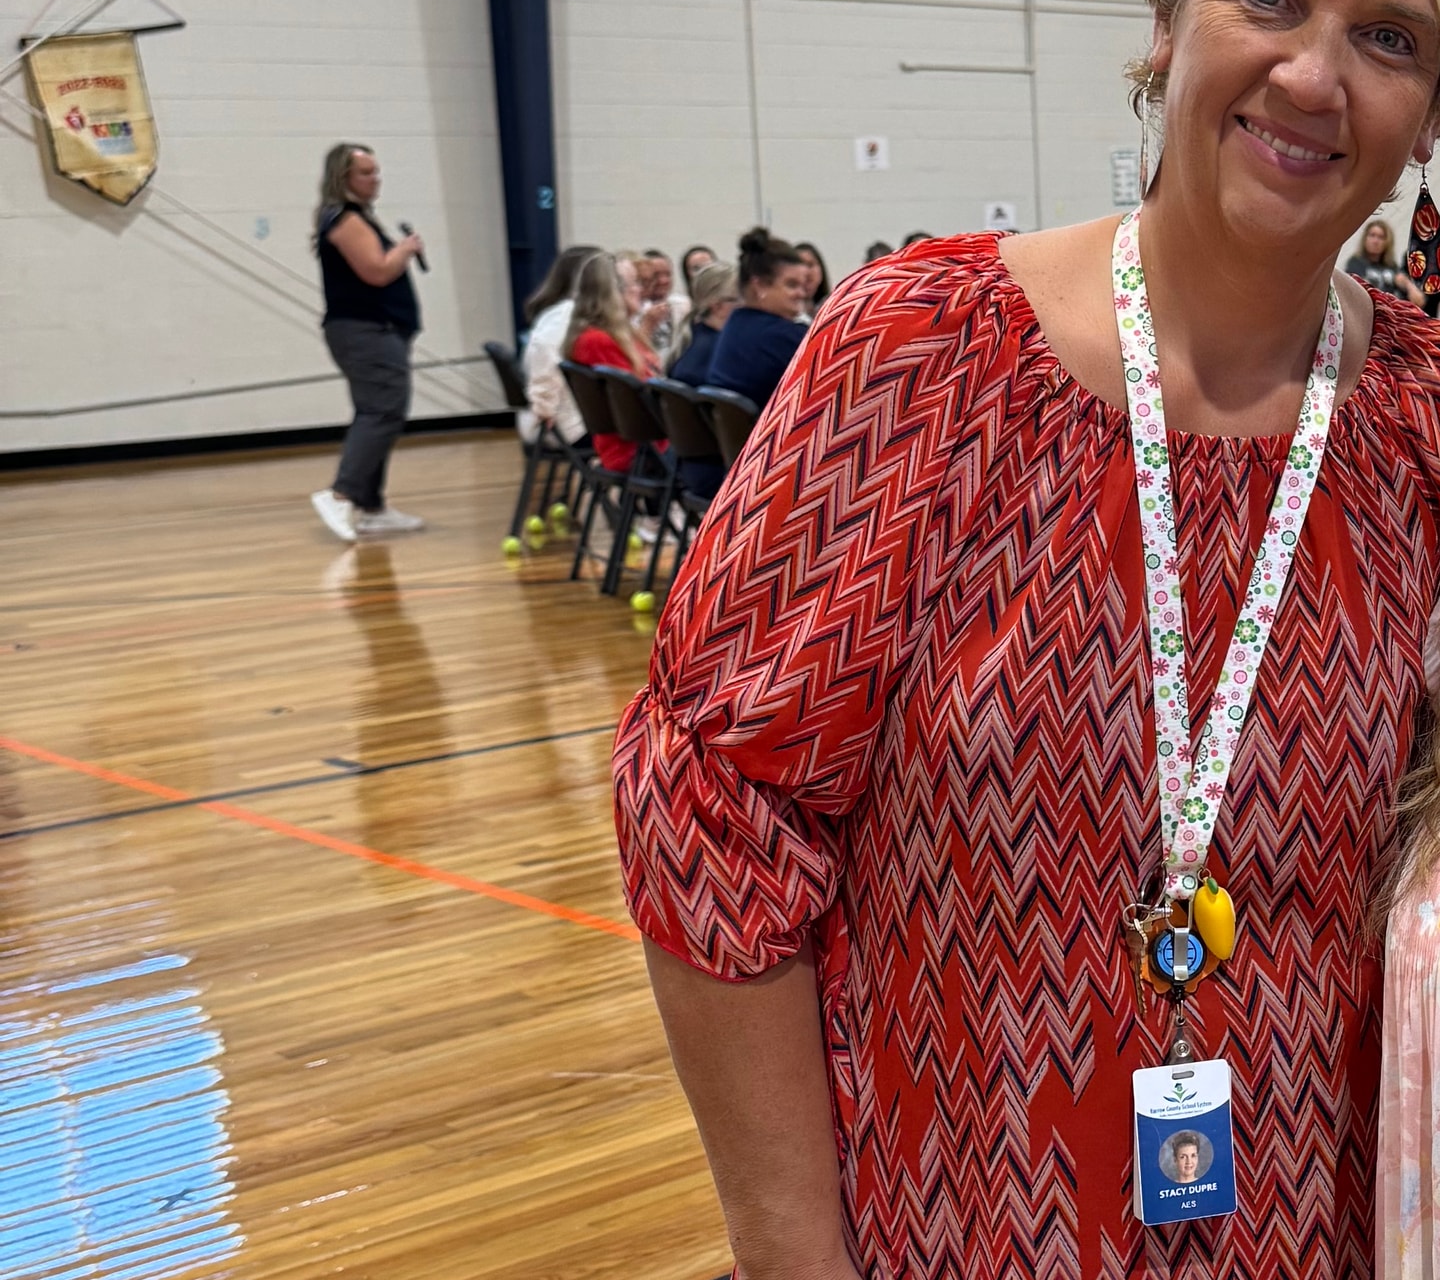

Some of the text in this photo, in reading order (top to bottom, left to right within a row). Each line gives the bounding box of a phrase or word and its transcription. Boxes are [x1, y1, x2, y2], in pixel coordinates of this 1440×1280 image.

[537, 186, 553, 209] 2
[1159, 1182, 1218, 1199] STACY DUPRE
[1181, 1200, 1197, 1209] AES
